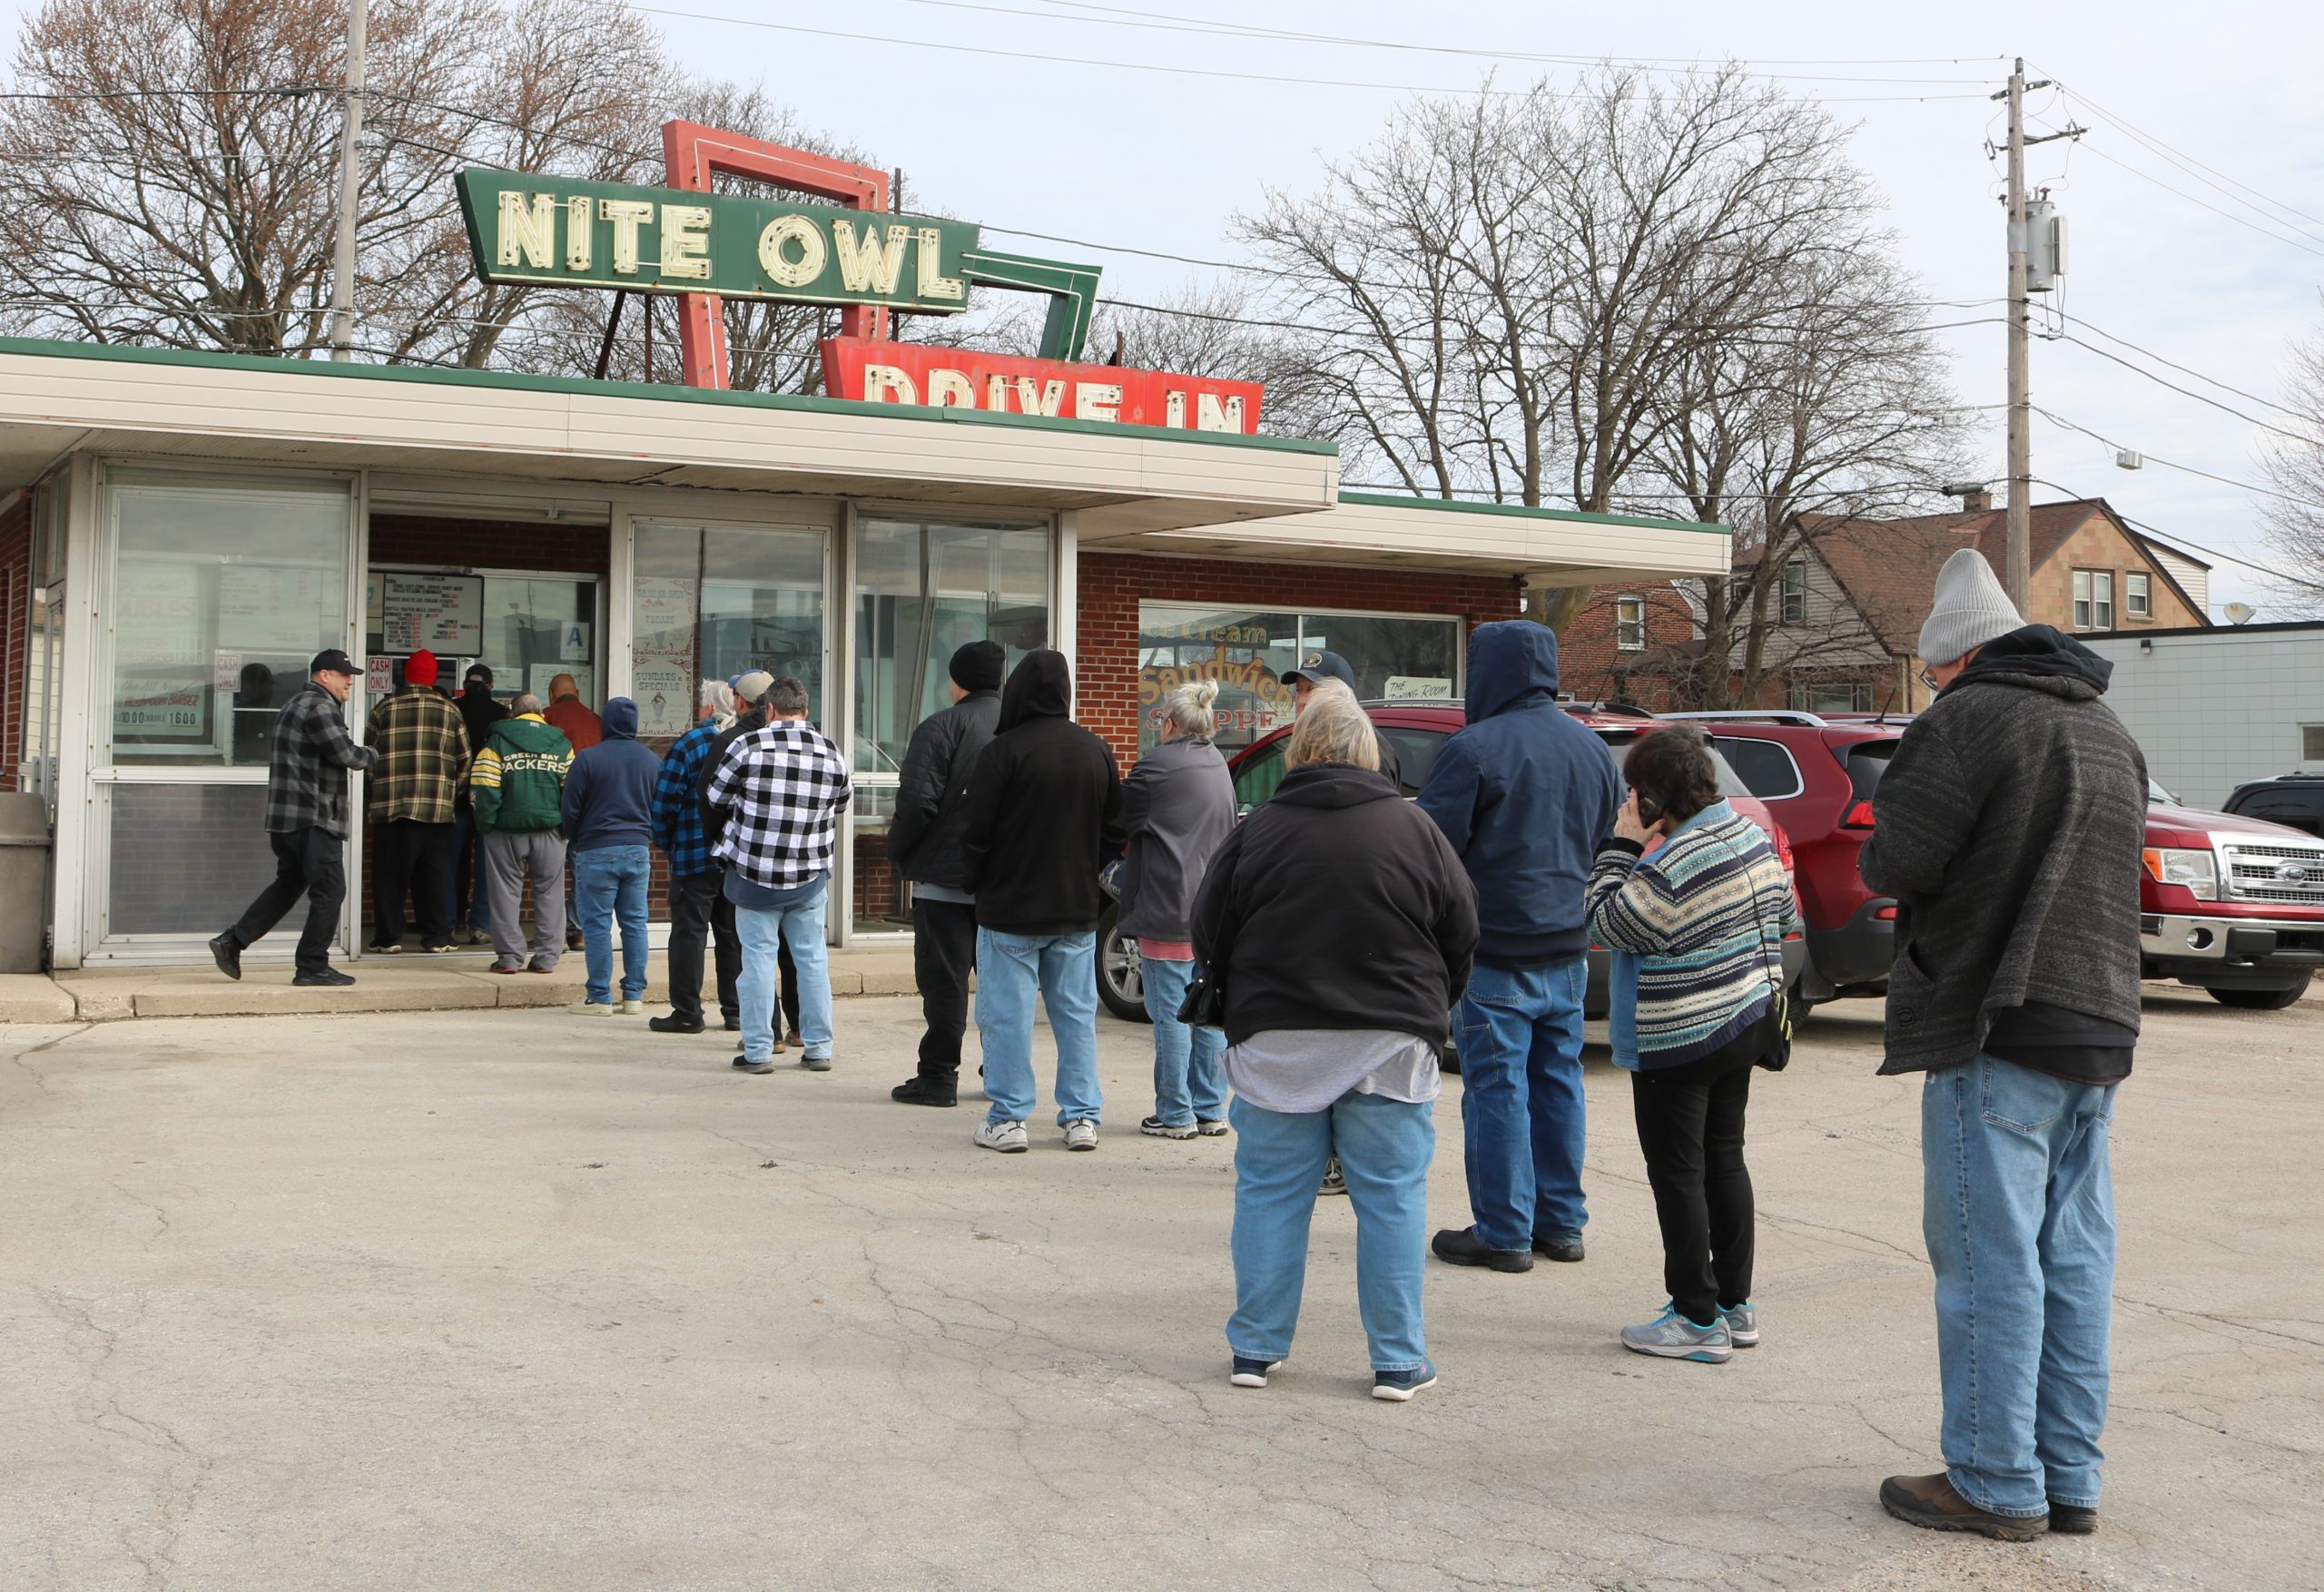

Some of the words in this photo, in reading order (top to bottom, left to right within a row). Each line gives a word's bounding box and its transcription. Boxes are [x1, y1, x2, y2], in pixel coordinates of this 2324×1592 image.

[497, 191, 713, 280] NITE
[757, 213, 966, 300] OWL
[1166, 388, 1247, 435] IN
[566, 626, 584, 647] A
[217, 656, 239, 672] CASH
[370, 659, 389, 673] CASH
[788, 659, 822, 677] OW
[217, 673, 239, 689] ONLY
[370, 675, 389, 690] ONLY
[635, 673, 676, 682] SUNDAES
[1138, 644, 1295, 715] Sandwich
[638, 682, 680, 691] SPECIALS
[1390, 681, 1408, 692] THE
[1421, 684, 1448, 698] ROOM
[170, 712, 196, 724] 1600
[1146, 707, 1281, 732] SPPE
[503, 752, 538, 762] GREEN
[541, 753, 559, 762] BAY
